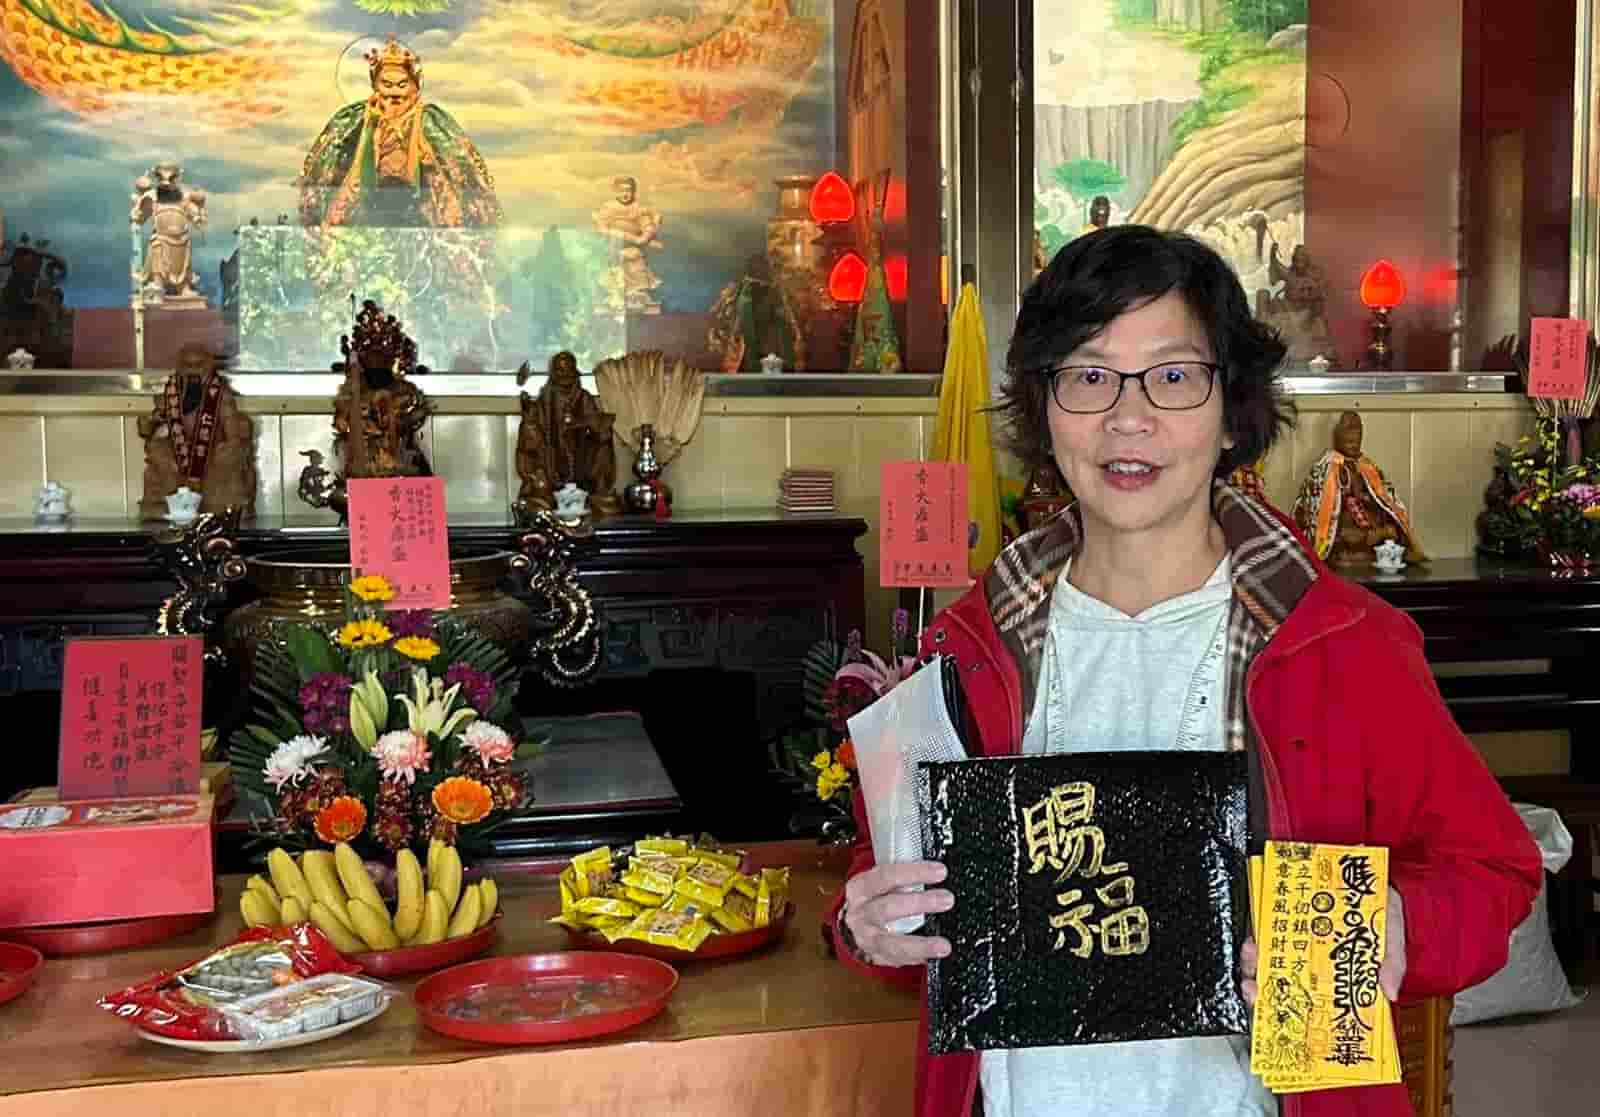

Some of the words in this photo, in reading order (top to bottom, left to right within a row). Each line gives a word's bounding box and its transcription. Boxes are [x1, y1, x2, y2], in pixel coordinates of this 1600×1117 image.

[388, 484, 407, 561] 香火鼎盛
[913, 466, 932, 542] 香火鼎盛
[1022, 780, 1150, 960] 賜福
[1270, 845, 1292, 969] 如意春風招財旺
